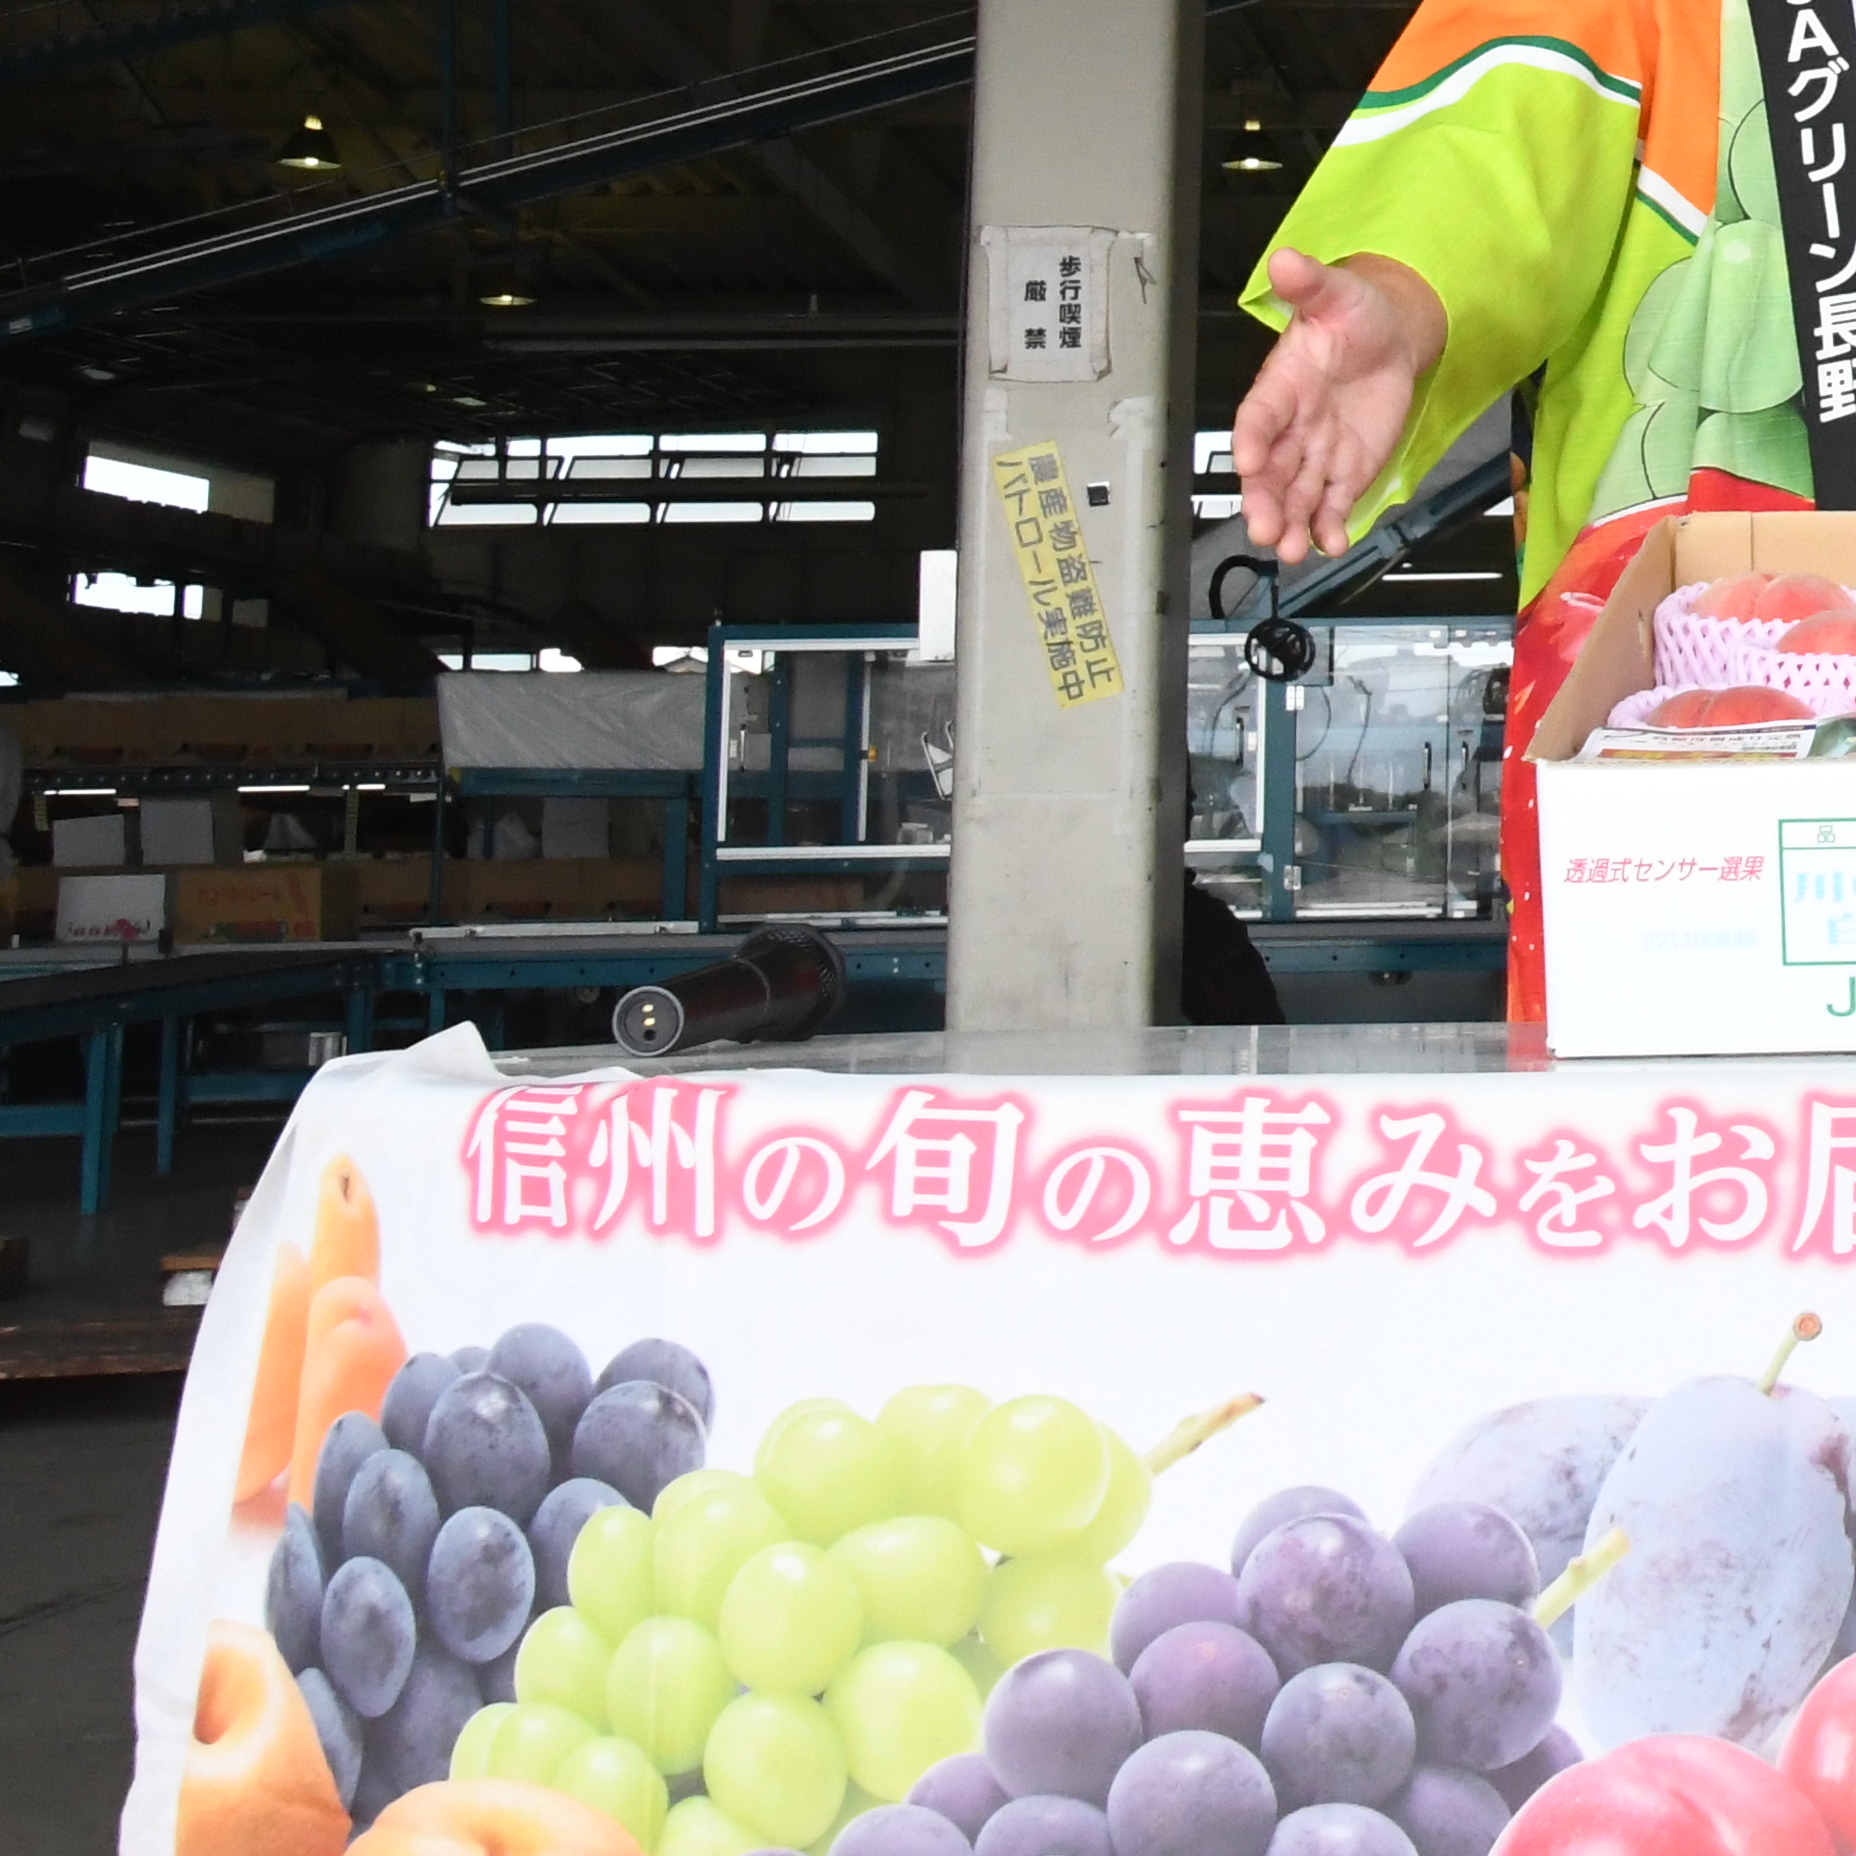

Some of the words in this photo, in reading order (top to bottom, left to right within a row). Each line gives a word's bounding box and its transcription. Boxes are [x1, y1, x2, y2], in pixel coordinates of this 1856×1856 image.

[1059, 255, 1082, 350] 歩行喫煙
[996, 461, 1086, 700] パトロール実施中
[1562, 854, 1765, 885] 透過式センサー選果
